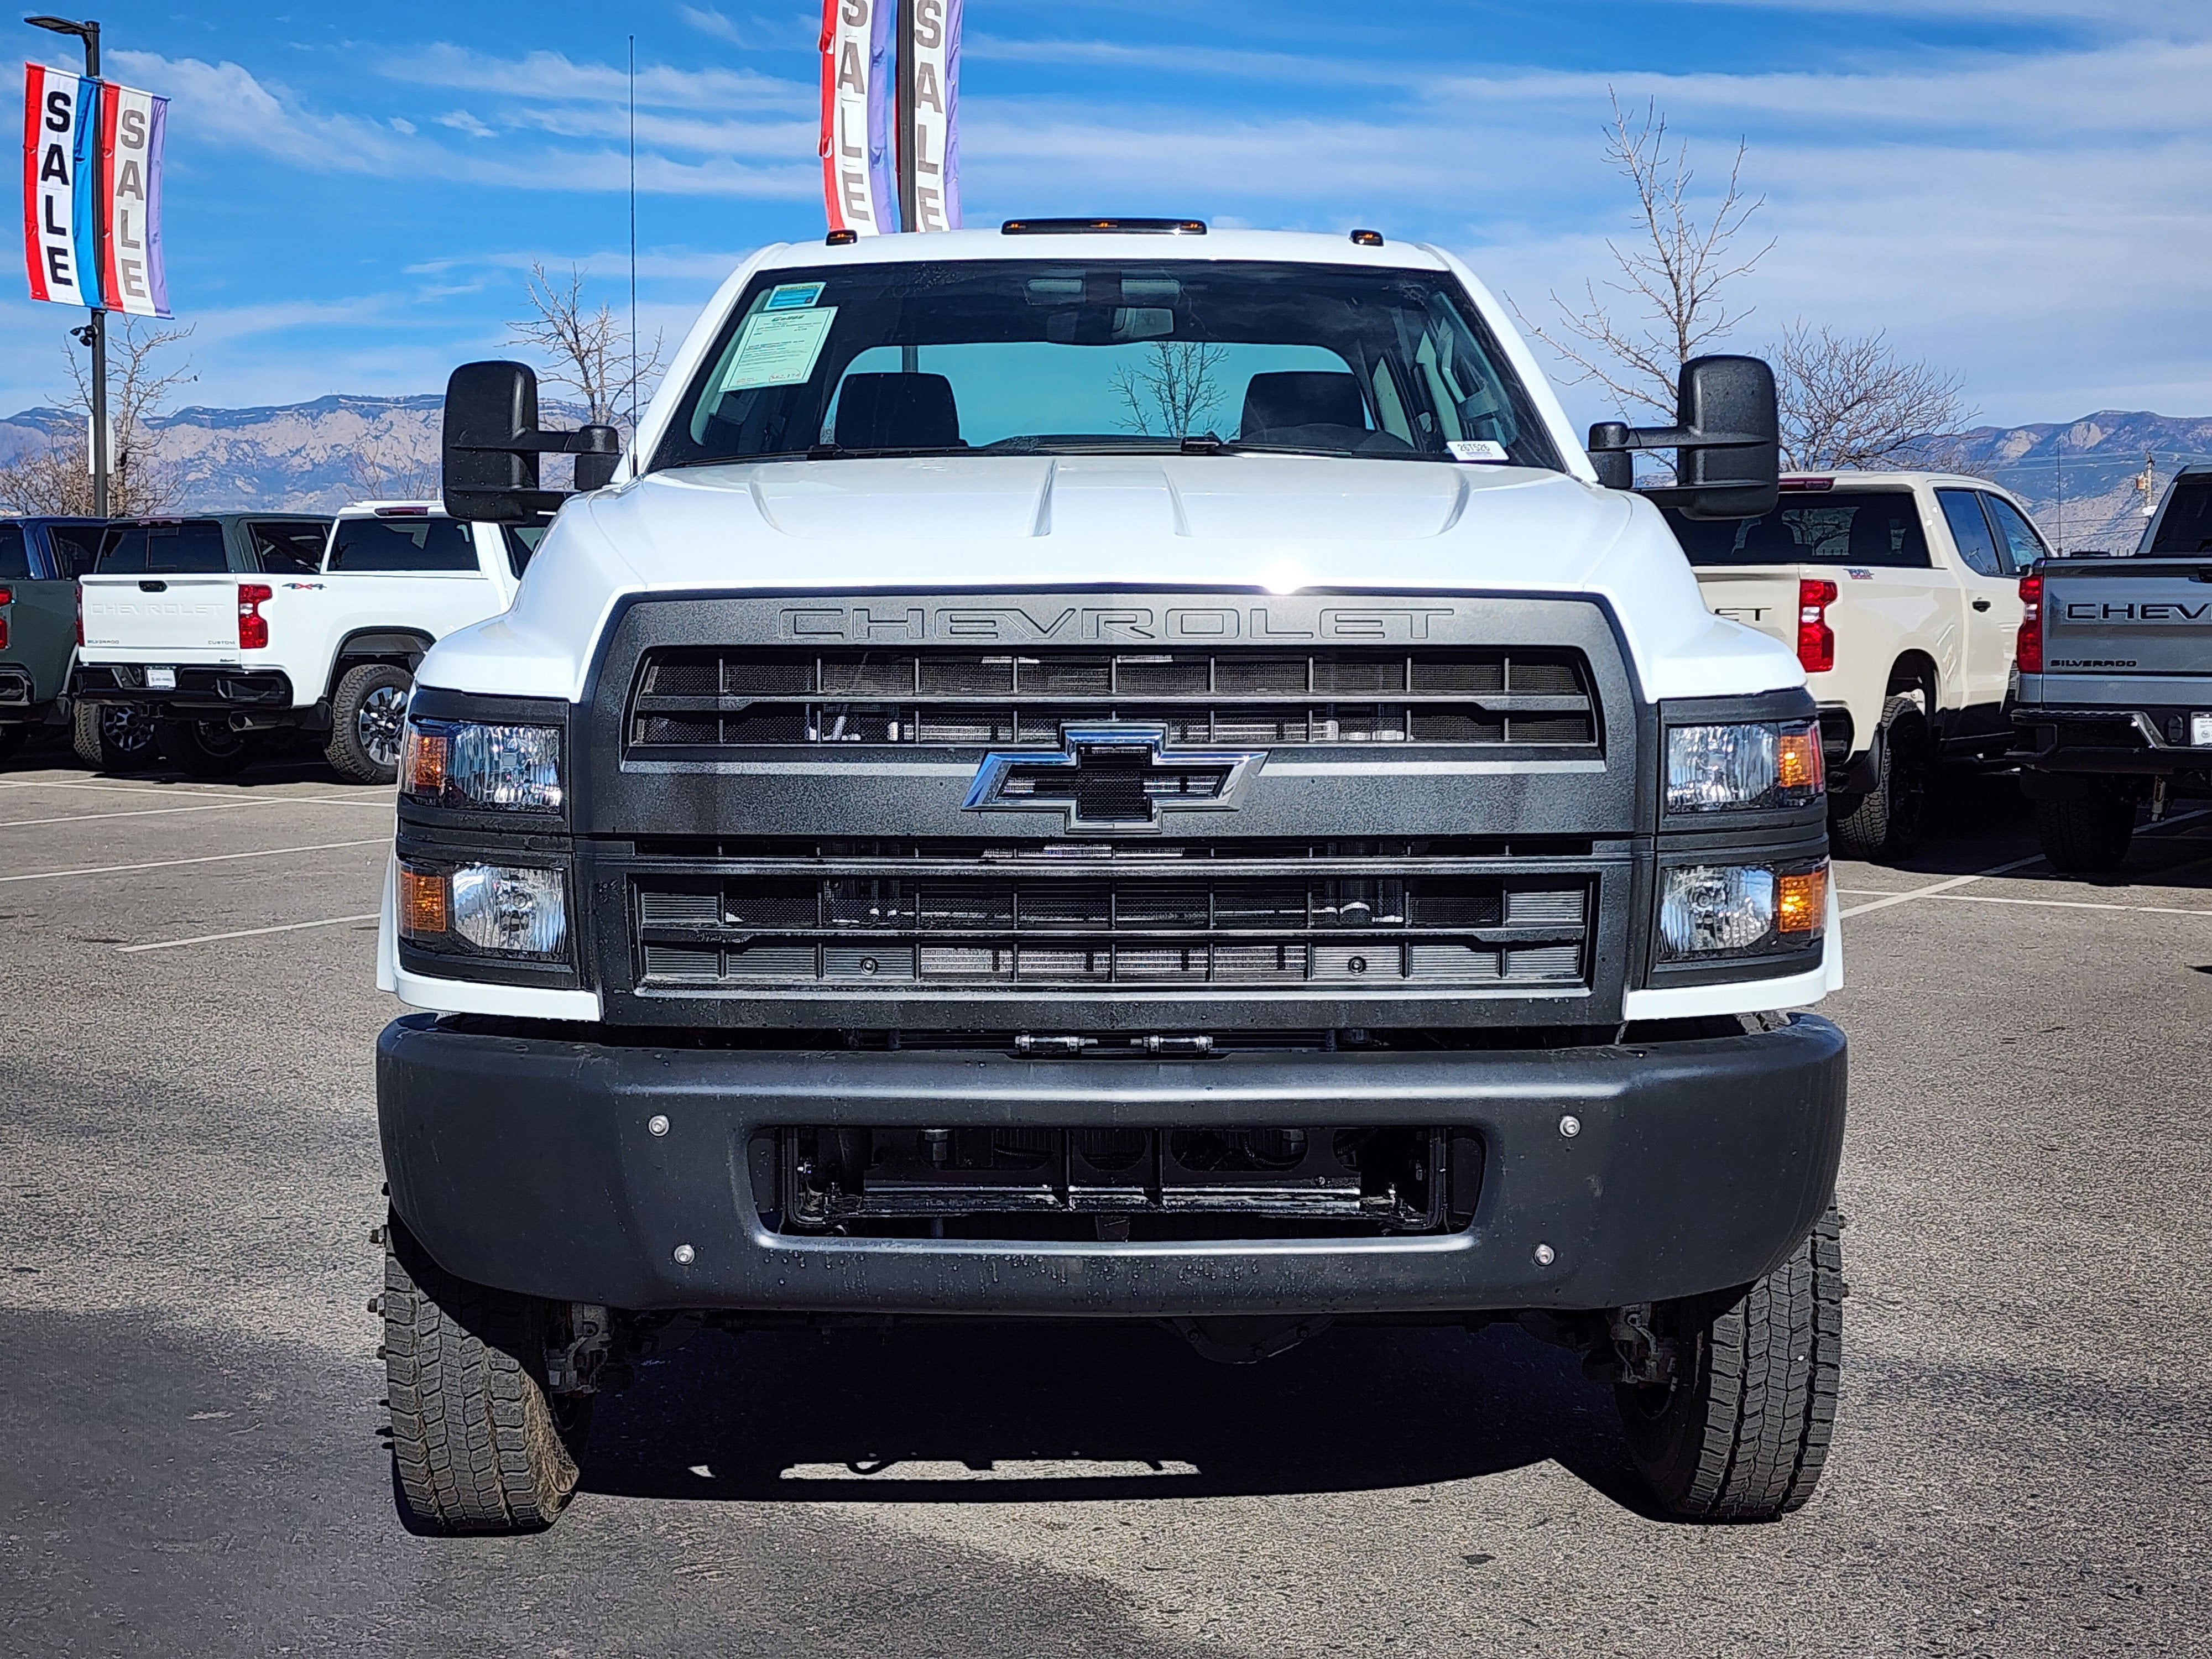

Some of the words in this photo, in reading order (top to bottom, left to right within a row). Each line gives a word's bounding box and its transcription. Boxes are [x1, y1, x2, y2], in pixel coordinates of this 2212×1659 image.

[40, 91, 74, 286] SALE
[116, 109, 147, 299] SALE
[837, 0, 870, 222] SALE
[915, 0, 943, 233] SALE
[90, 603, 226, 616] CHEVROLET
[778, 607, 1454, 641] CHEVROLET
[2050, 659, 2137, 667] SILVERADO
